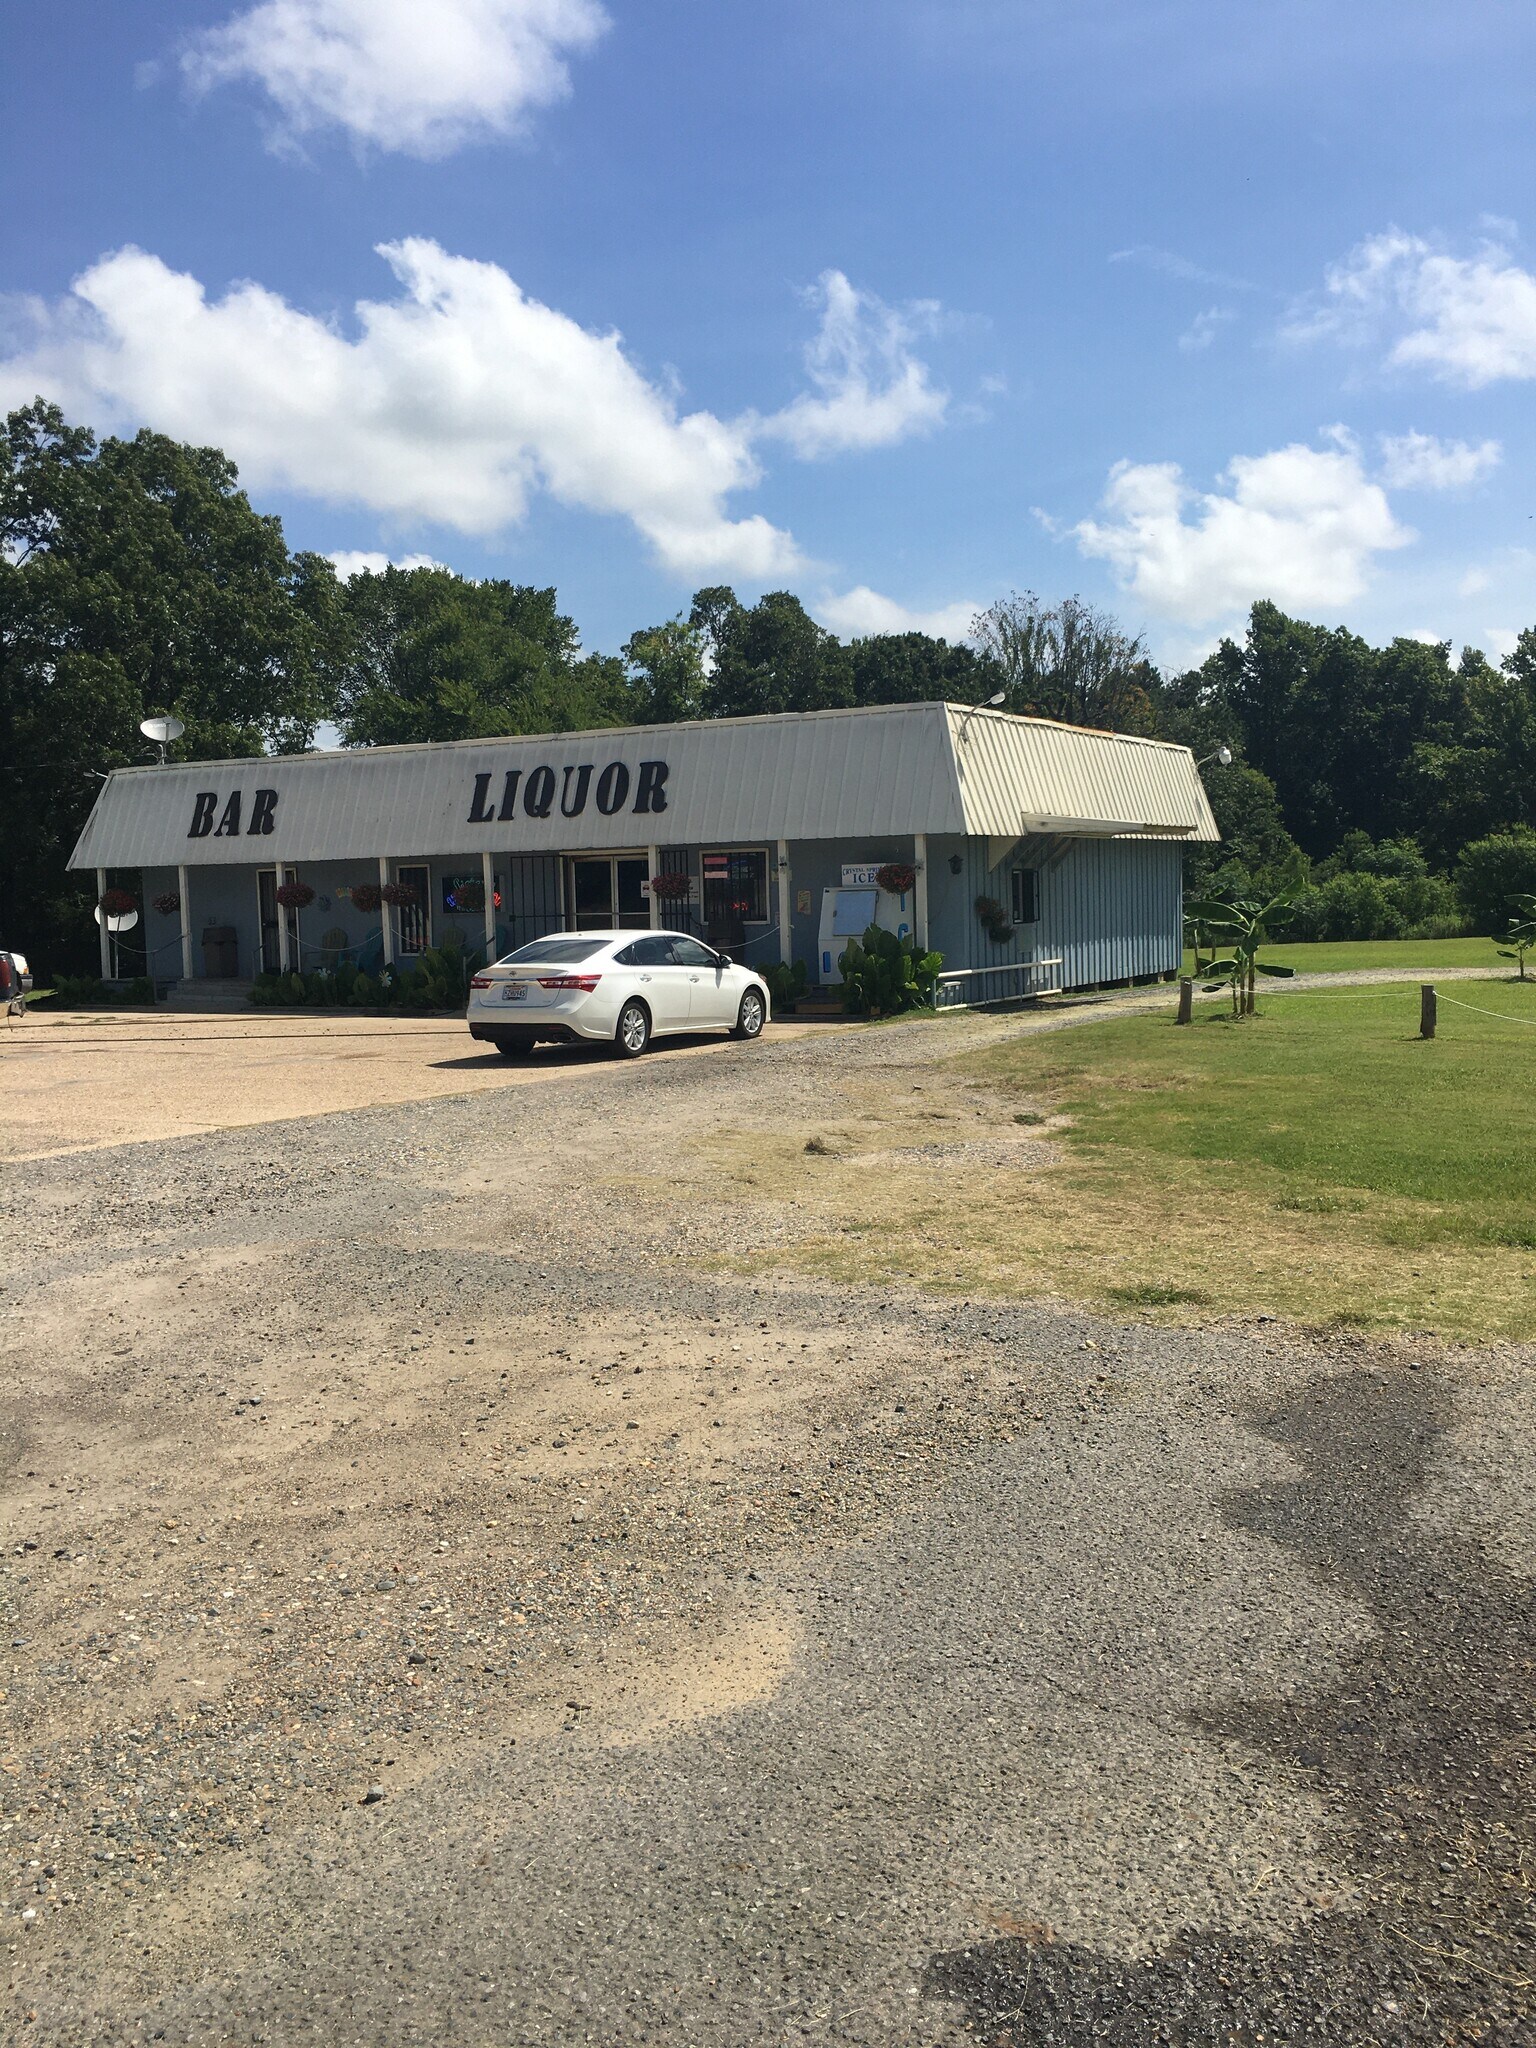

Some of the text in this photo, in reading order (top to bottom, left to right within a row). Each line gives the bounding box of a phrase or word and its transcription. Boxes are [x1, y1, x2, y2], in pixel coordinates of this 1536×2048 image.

[467, 761, 669, 823] LIQUOR
[187, 789, 279, 838] BAR
[843, 867, 865, 876] CRYSTAL
[853, 873, 875, 883] ICE
